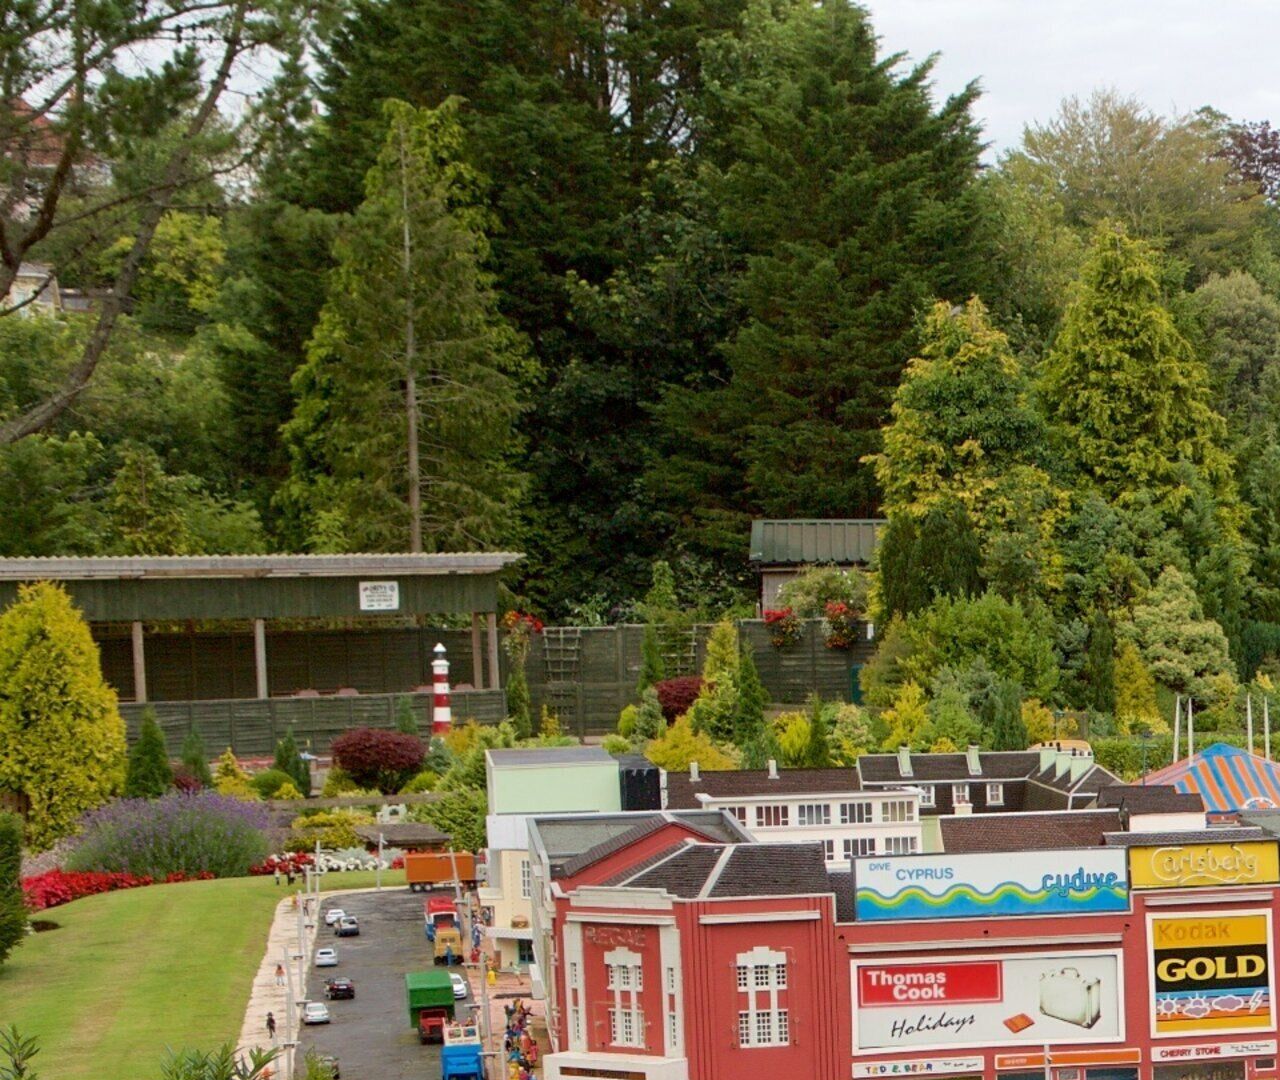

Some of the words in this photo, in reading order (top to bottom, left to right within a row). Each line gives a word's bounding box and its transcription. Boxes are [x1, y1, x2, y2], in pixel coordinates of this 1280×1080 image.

[869, 862, 891, 871] DIVE
[1152, 847, 1258, 882] Carlsberg
[896, 868, 954, 881] CYPRUS
[1042, 867, 1118, 898] cydive
[1157, 921, 1230, 941] Kodak
[1157, 955, 1265, 982] GOLD
[867, 970, 946, 985] Thomas
[893, 983, 945, 1000] Cook
[891, 1012, 976, 1038] Holidays
[1160, 1049, 1191, 1058] CHERRY
[865, 1065, 886, 1074] TED
[904, 1063, 933, 1073] BEAR
